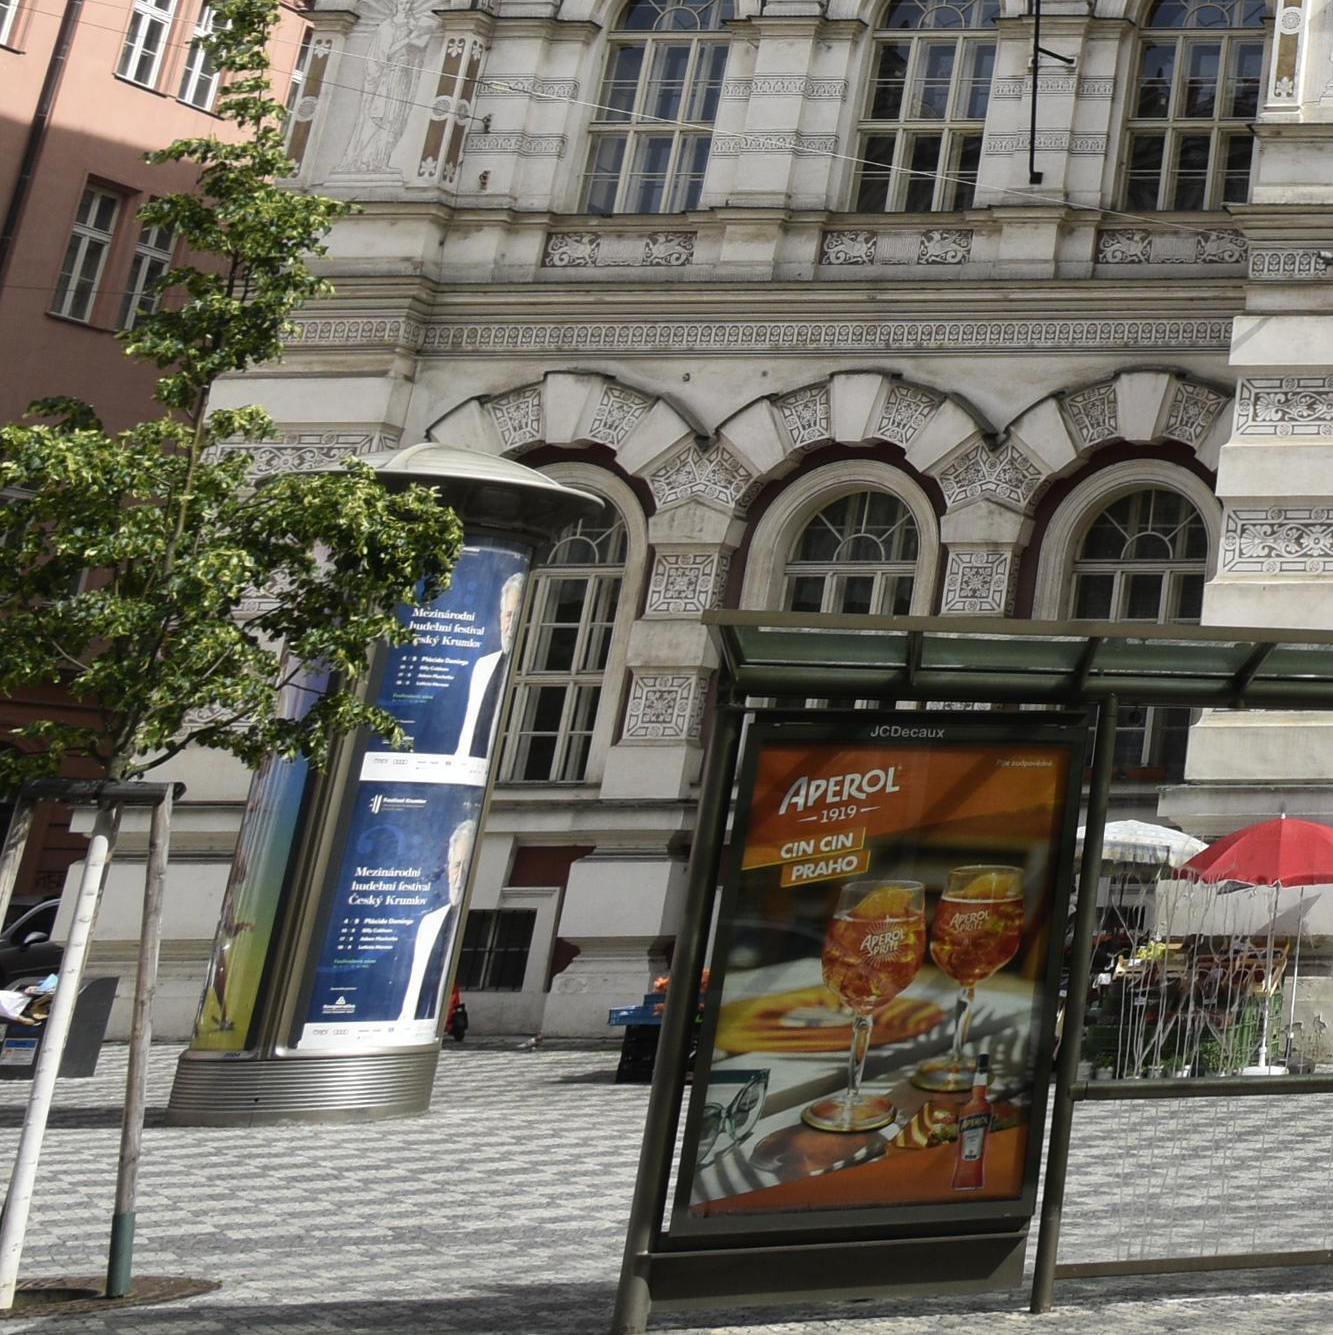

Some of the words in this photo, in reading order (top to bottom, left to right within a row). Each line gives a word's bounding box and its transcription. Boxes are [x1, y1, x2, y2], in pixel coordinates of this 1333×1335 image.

[453, 623, 485, 636] festival
[870, 725, 945, 739] JCDecaux
[778, 765, 900, 815] APEROL
[820, 805, 857, 824] 1919
[780, 838, 814, 859] CIN
[819, 832, 854, 853] CIN
[355, 866, 421, 878] Mezinárodní
[791, 855, 858, 882] PRAHO
[352, 881, 397, 891] hudební
[398, 881, 432, 892] festival
[348, 893, 383, 908] Český
[385, 896, 429, 906] Krumlov
[950, 909, 990, 927] APEROL
[860, 928, 905, 951] APEROL
